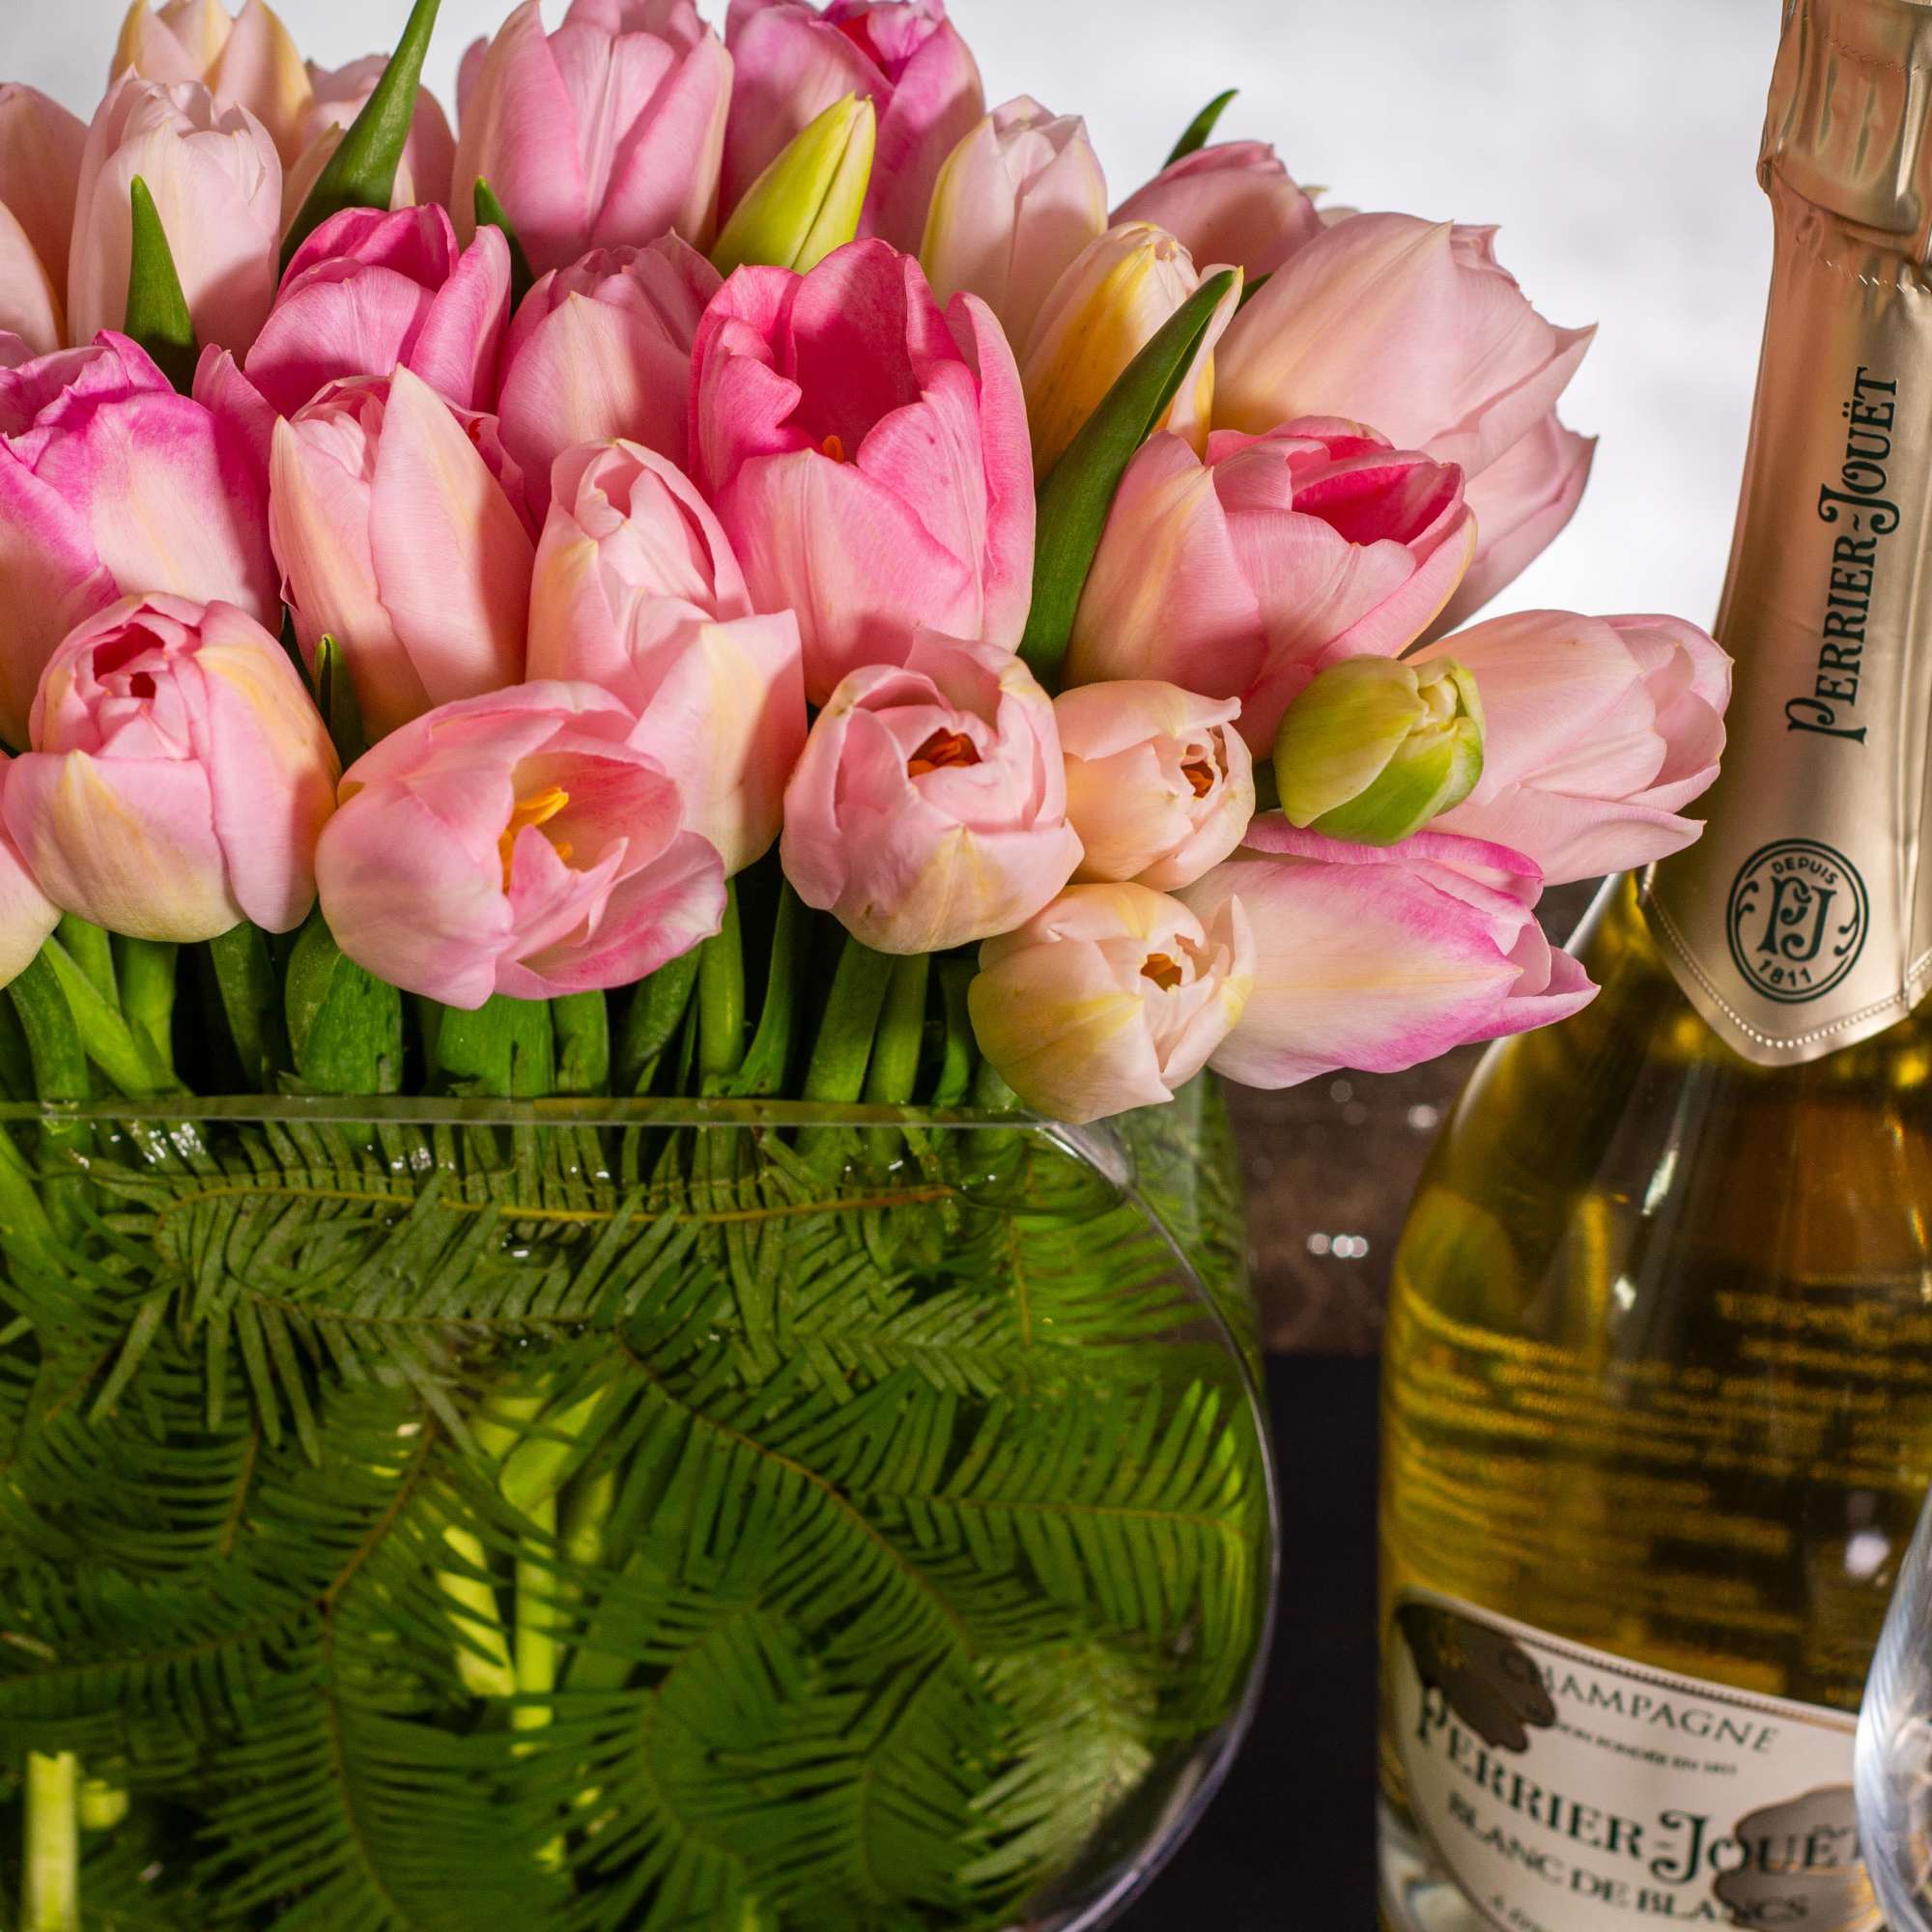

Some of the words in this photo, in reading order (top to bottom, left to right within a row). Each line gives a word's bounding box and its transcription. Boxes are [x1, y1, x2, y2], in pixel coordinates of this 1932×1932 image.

[1784, 366, 1900, 745] PERRIER-JOUËT
[1770, 856, 1839, 886] DEPUIS
[1758, 959, 1812, 987] 1811
[1449, 1790, 1565, 1887] BLANC
[1570, 1867, 1631, 1911] DE
